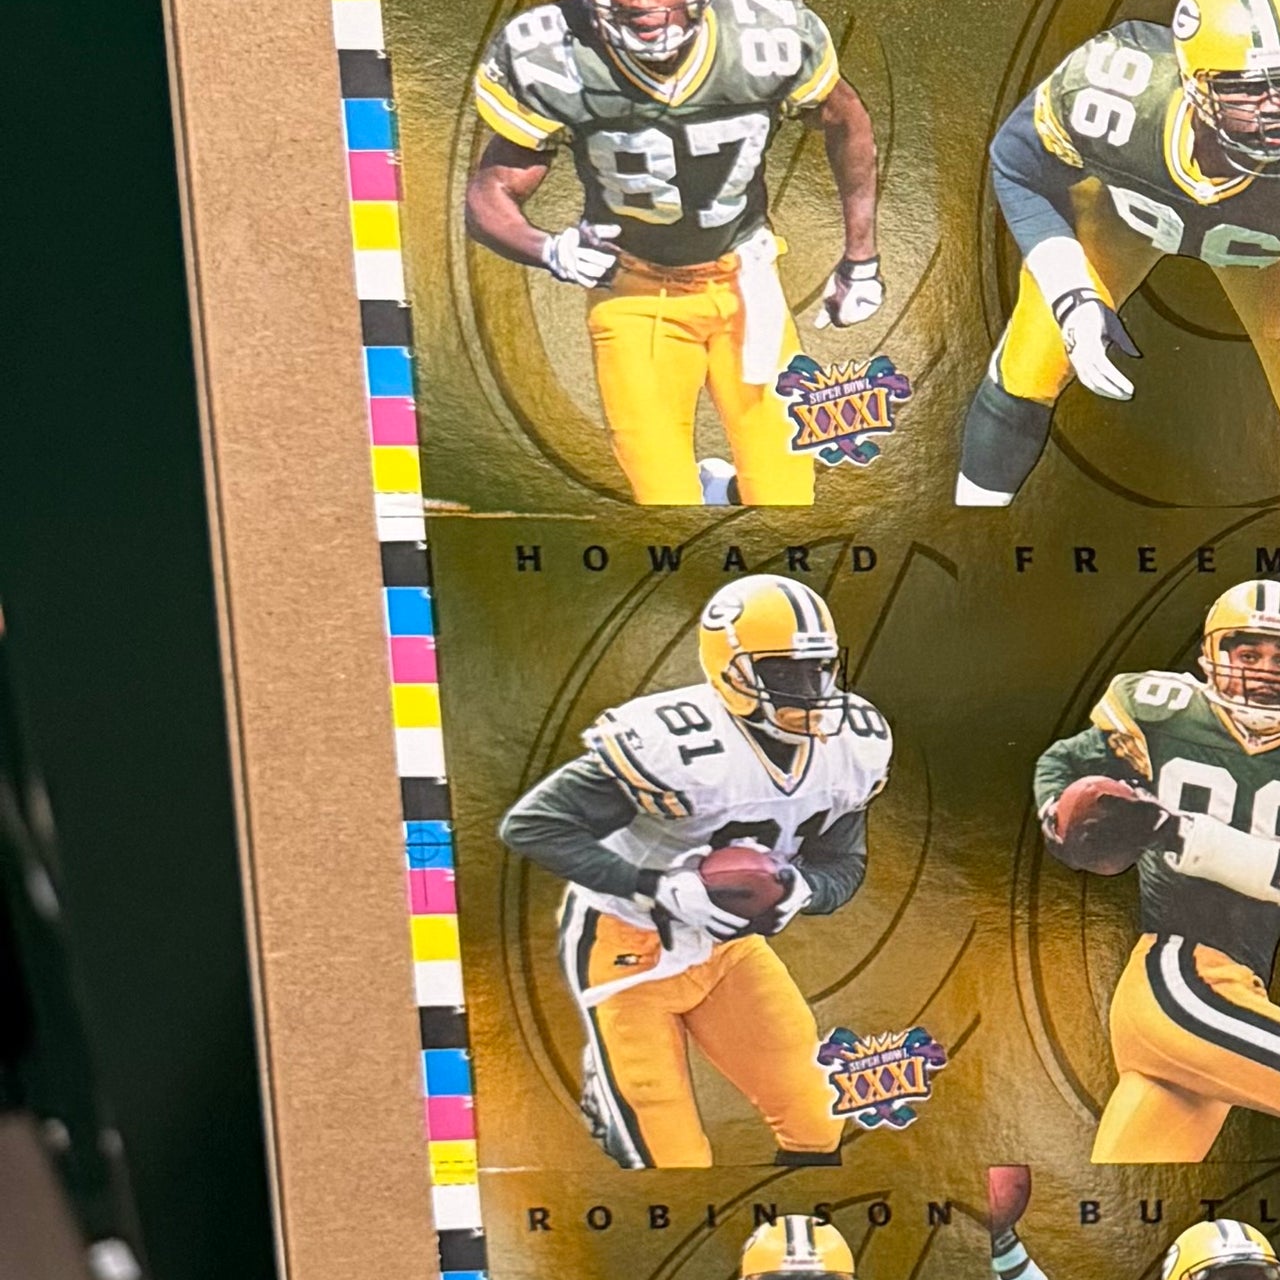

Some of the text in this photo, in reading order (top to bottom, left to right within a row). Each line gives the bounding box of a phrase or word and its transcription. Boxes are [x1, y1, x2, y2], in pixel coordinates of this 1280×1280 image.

[506, 14, 581, 96] 87
[1073, 43, 1152, 147] 96
[590, 113, 770, 228] 87
[794, 388, 891, 445] XXXI
[809, 378, 872, 404] SUPER BOWL
[516, 545, 878, 573] HOWARD
[656, 701, 725, 766] 81
[834, 1057, 927, 1110] XXXI
[528, 1200, 953, 1232] ROBINSON
